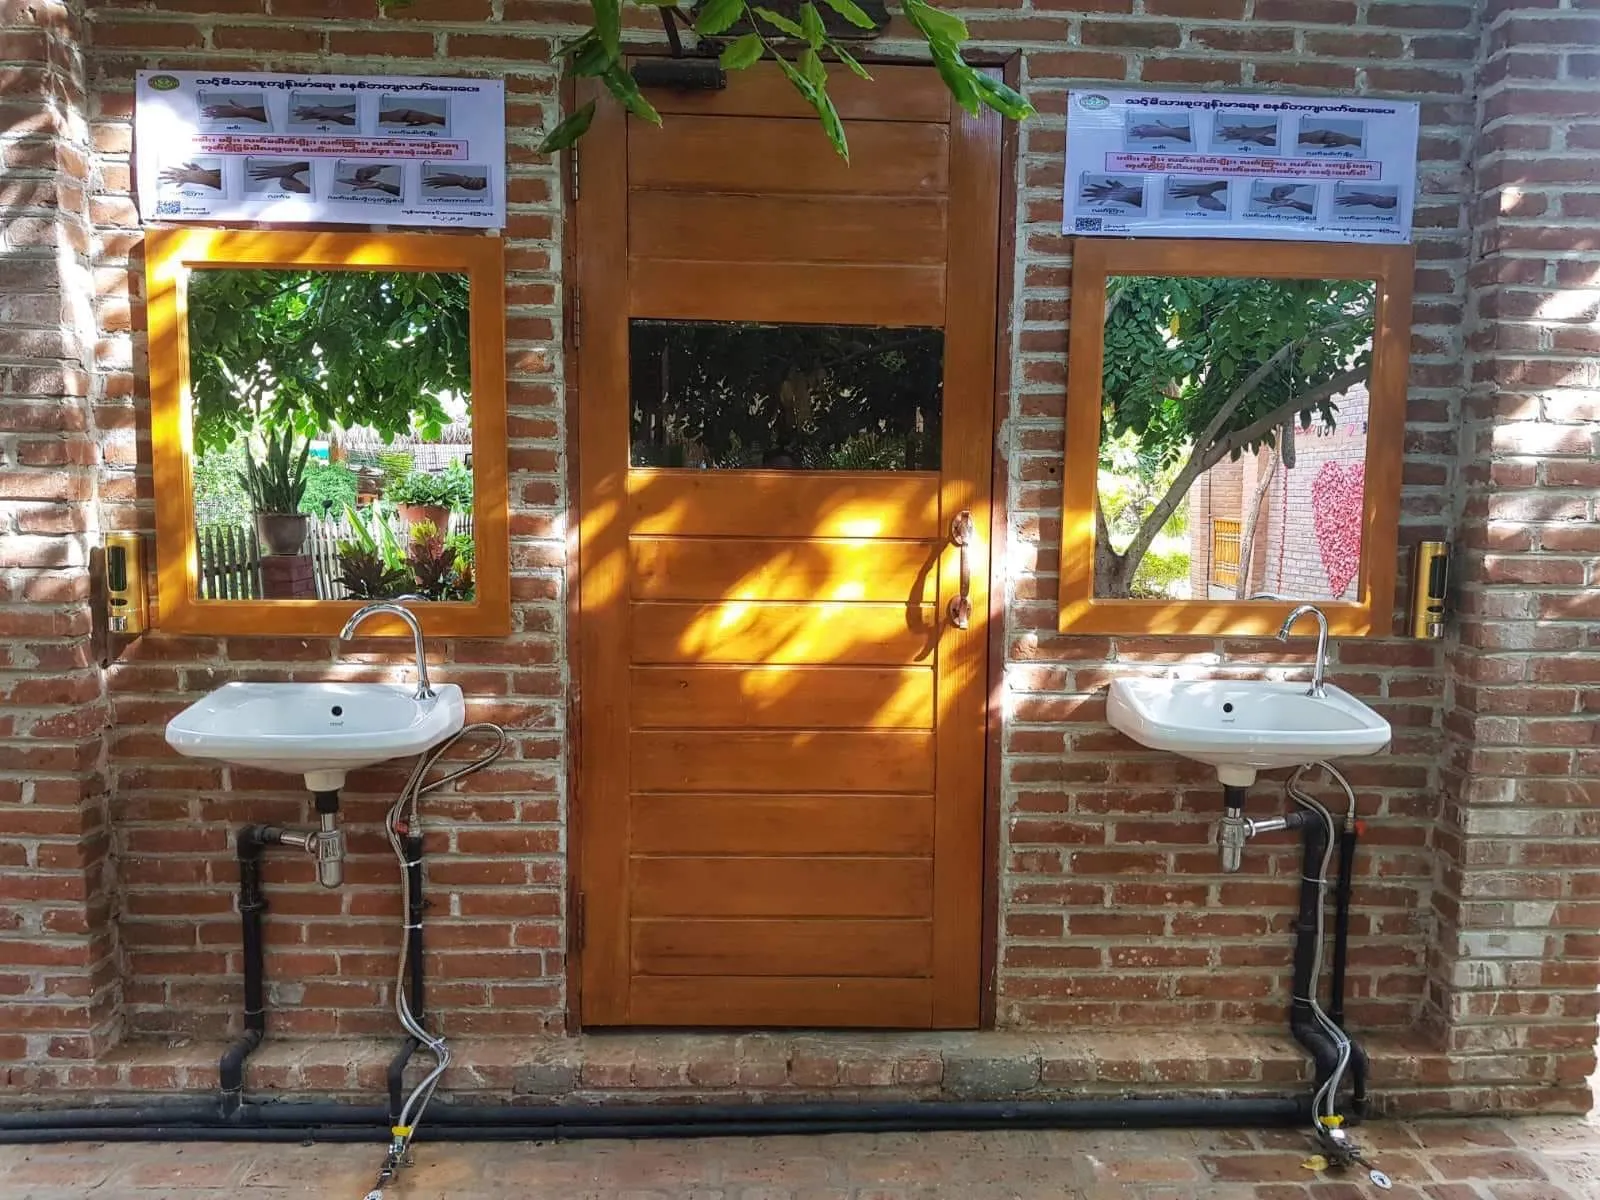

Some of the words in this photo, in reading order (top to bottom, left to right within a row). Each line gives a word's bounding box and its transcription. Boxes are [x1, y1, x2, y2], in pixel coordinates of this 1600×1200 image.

[195, 77, 336, 91] သင့်မိသားစုကျန်းမာရေး
[339, 81, 481, 93] စနစ်တကျလက်ဆေးပေး
[1125, 97, 1260, 110] သင့်မိသားစုကျန်းမာရေး
[1262, 102, 1396, 115] စနစ်တကျလက်ဆေးပေး
